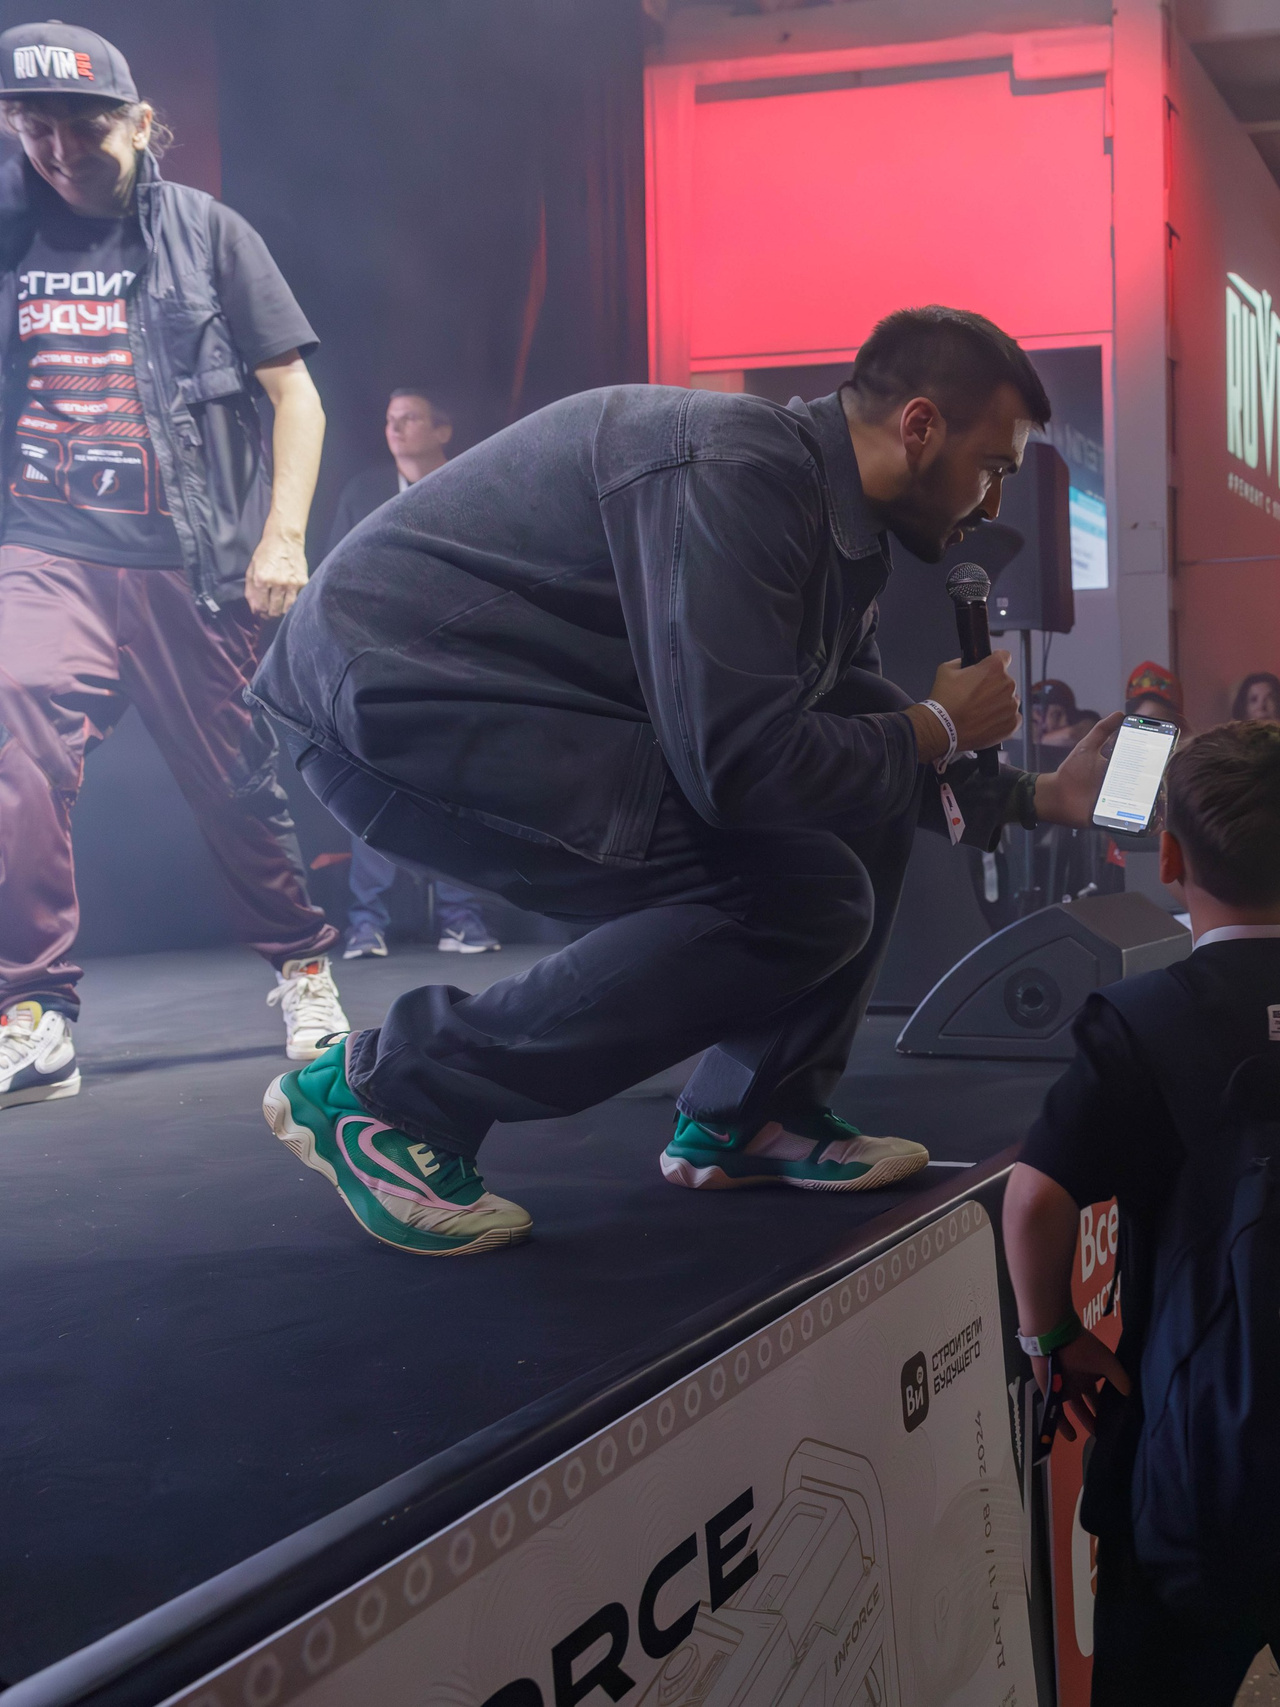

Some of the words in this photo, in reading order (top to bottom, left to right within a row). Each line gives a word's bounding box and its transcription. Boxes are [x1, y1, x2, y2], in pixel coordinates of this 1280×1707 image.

[1080, 1203, 1120, 1284] Все
[931, 1315, 983, 1372] СТРОИТЕЛИ
[933, 1340, 981, 1396] БУДУЩЕГО
[974, 1409, 988, 1478] 2024
[982, 1502, 993, 1538] 08
[834, 1582, 880, 1678] INFORCE
[991, 1591, 1006, 1670] ДАТА
